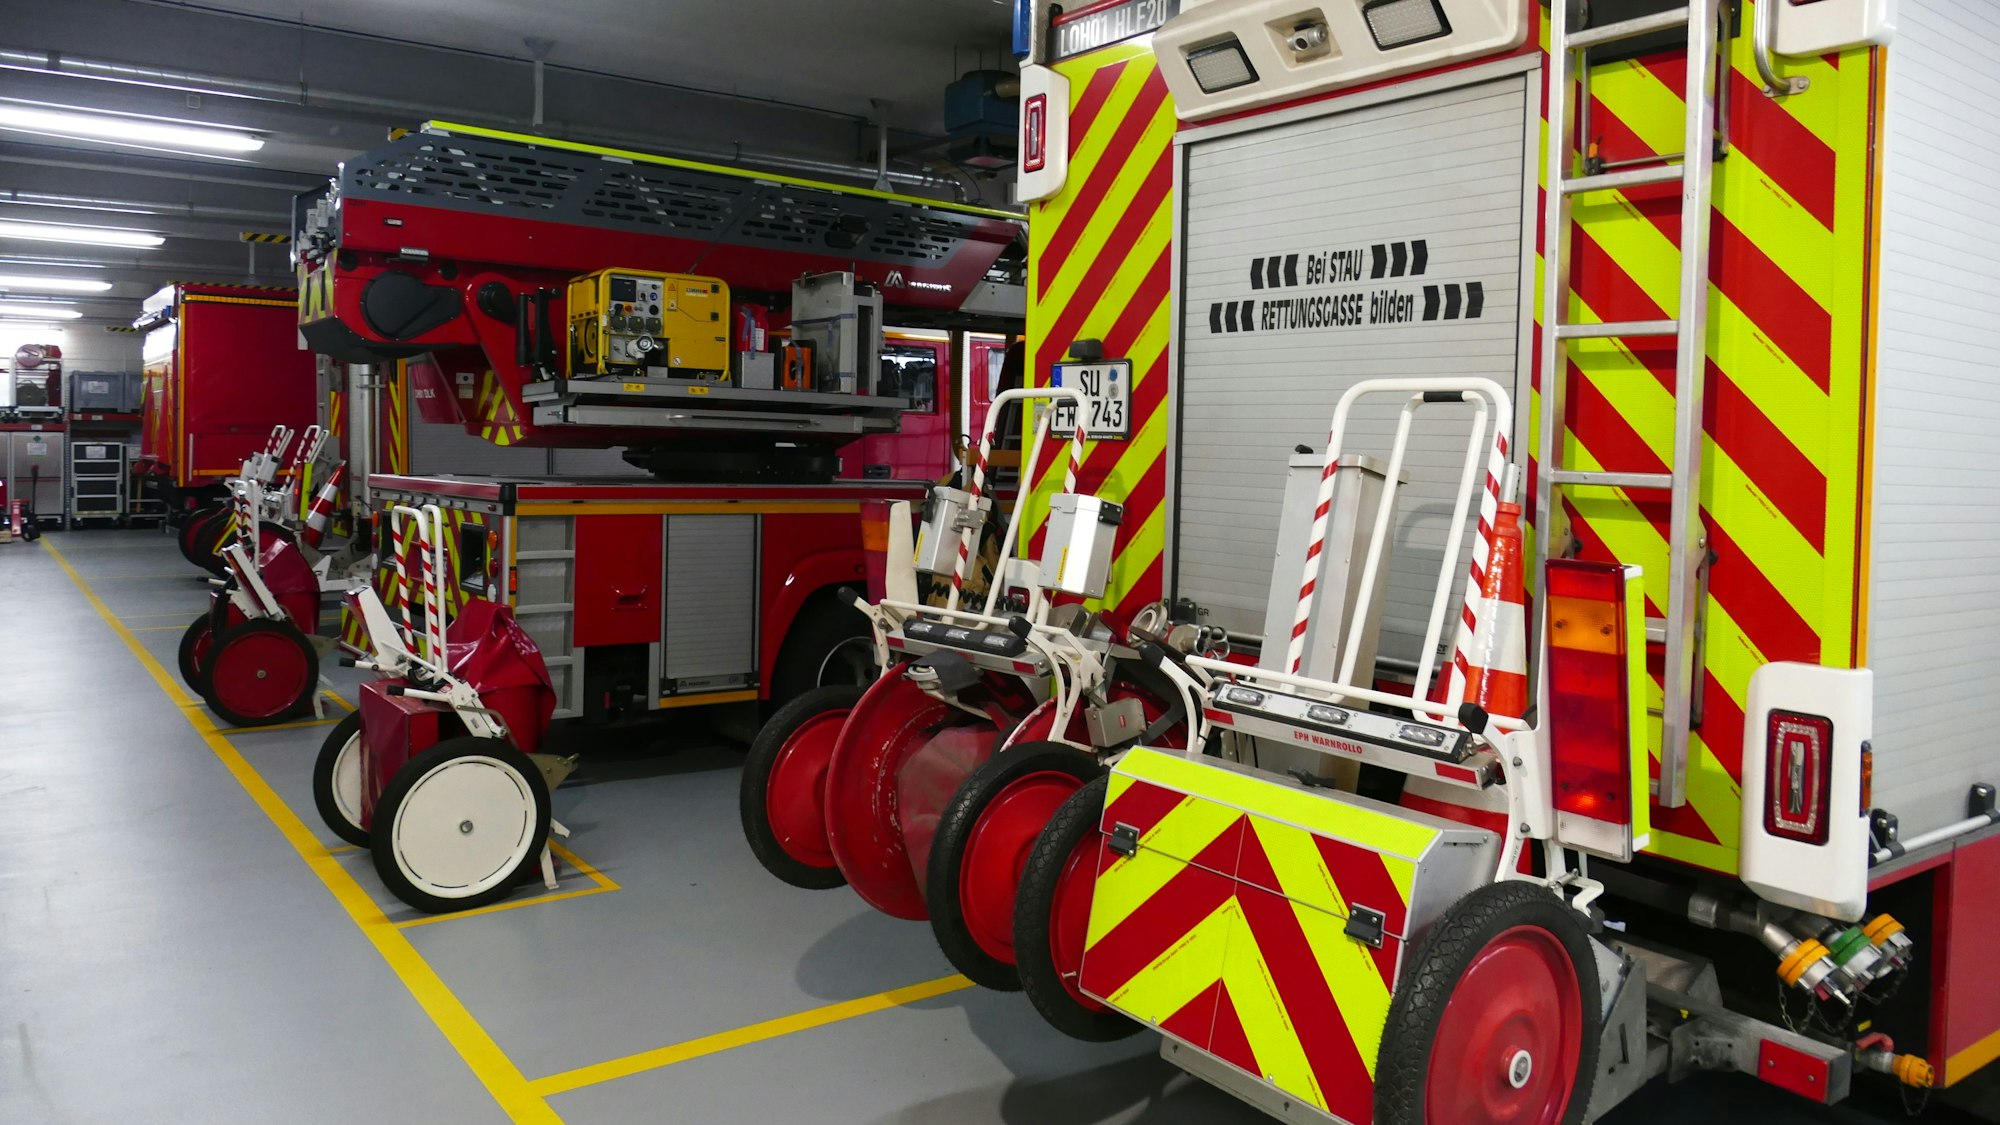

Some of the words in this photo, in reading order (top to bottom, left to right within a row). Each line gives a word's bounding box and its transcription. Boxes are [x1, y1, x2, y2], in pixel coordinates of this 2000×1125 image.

[1114, 0, 1167, 40] HLF20
[1306, 251, 1328, 285] Bei
[1329, 249, 1363, 283] STAU
[1261, 293, 1364, 331] RETTUNGSGASSE
[1369, 289, 1414, 325] bilden
[1080, 370, 1100, 397] SU
[1091, 400, 1123, 428] 743
[1294, 731, 1310, 742] EPH
[1312, 734, 1363, 754] WARNROLLO
